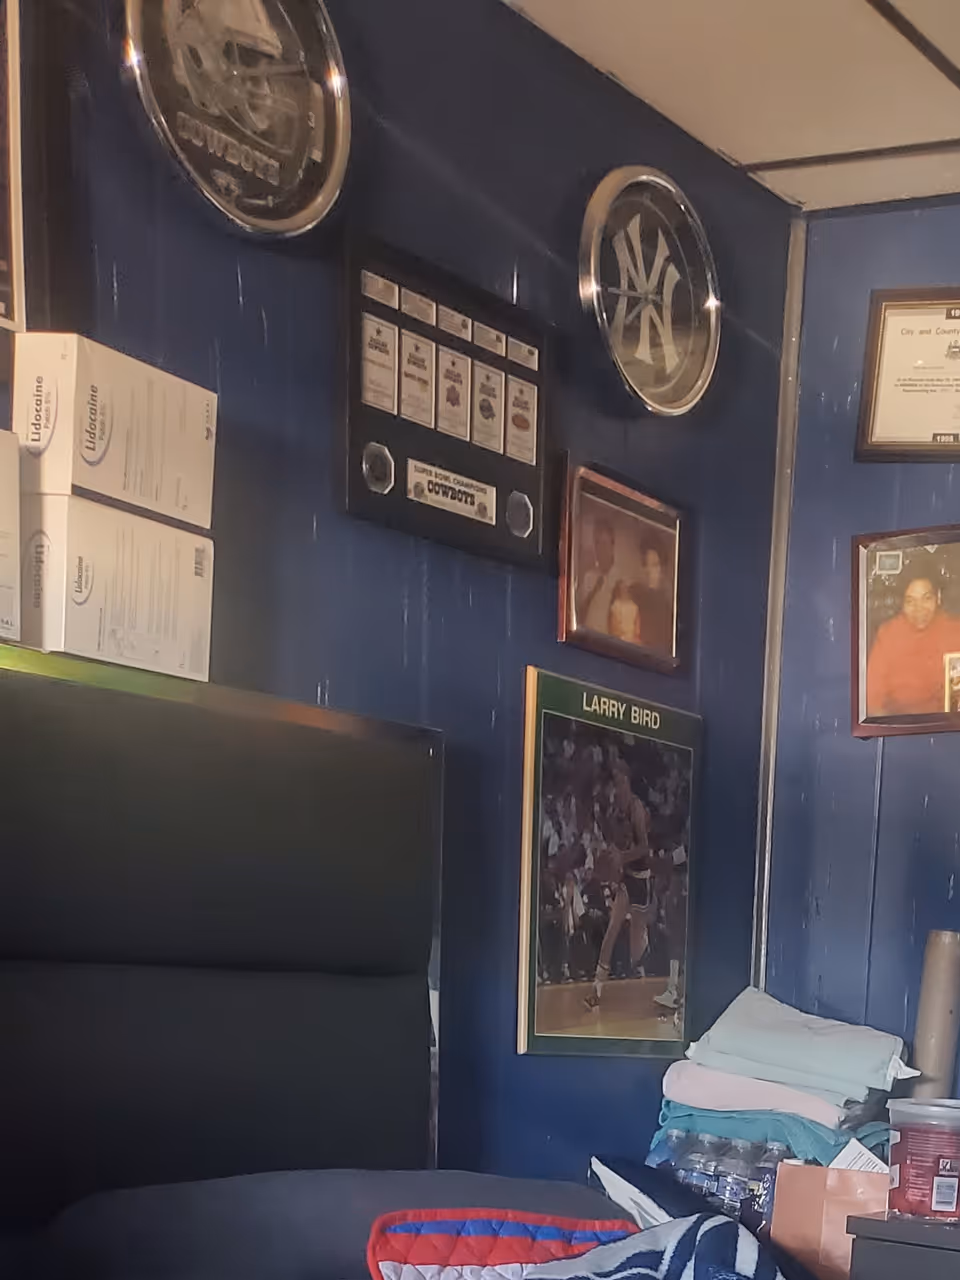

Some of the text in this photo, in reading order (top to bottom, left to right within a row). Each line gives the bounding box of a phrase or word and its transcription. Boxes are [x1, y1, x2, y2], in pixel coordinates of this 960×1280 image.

[900, 327, 915, 336] City
[935, 326, 960, 336] County
[31, 376, 43, 442] Lidocaine
[85, 384, 98, 451] Lidocaine
[427, 479, 475, 506] COWBOYS
[582, 691, 661, 730] LARRY BIRD
